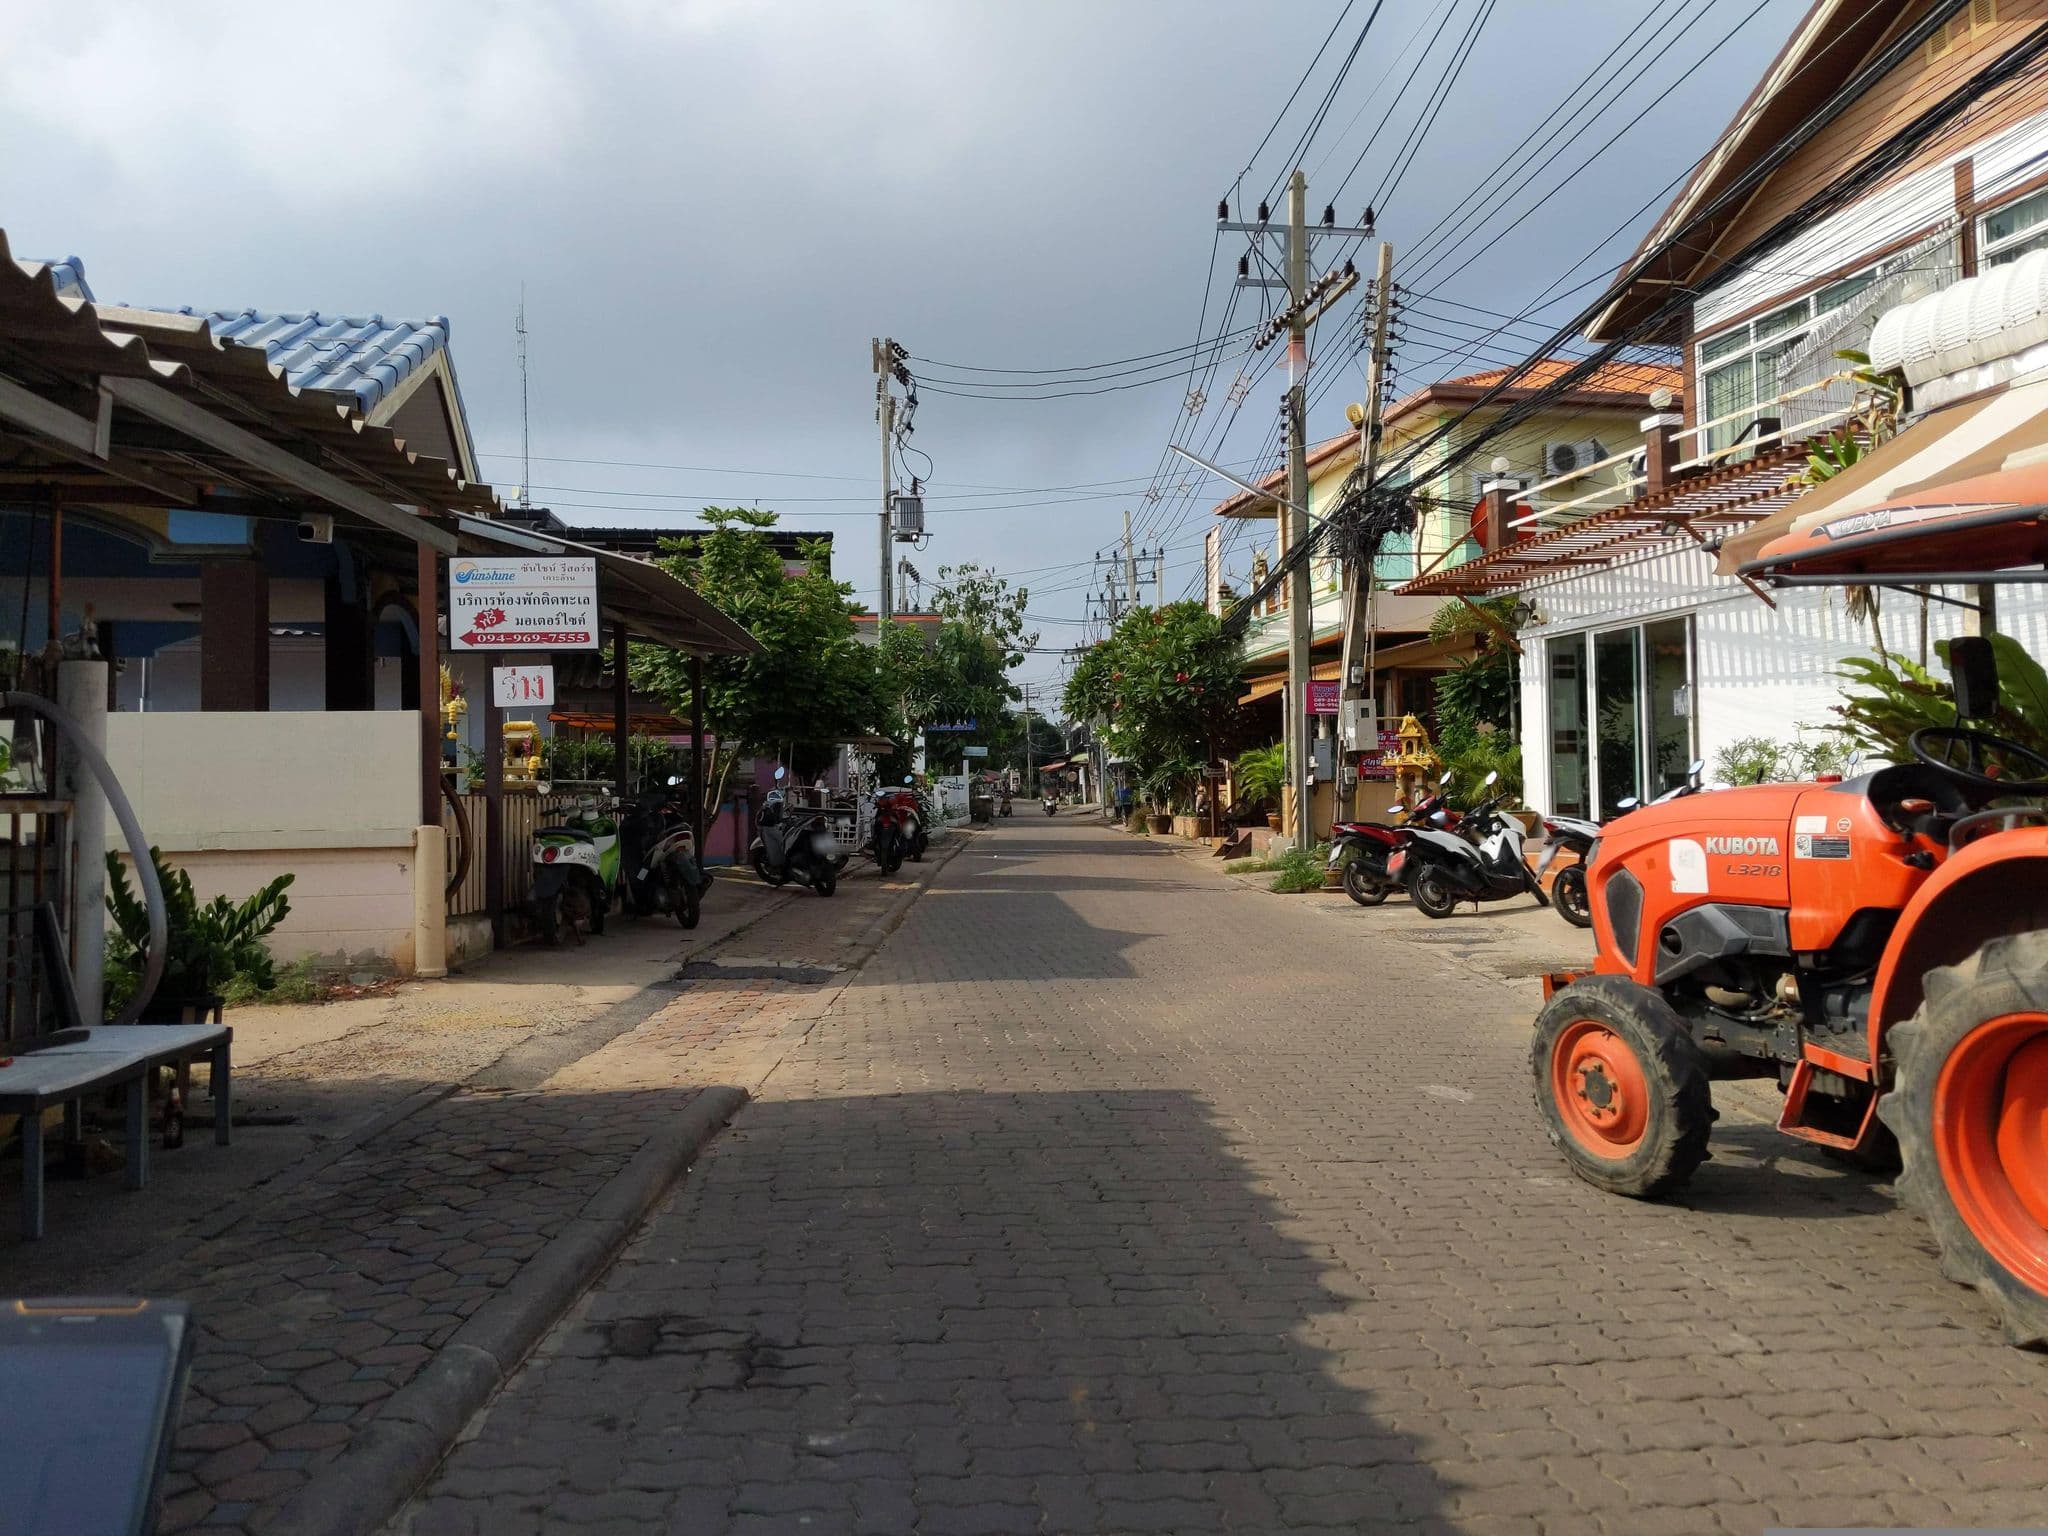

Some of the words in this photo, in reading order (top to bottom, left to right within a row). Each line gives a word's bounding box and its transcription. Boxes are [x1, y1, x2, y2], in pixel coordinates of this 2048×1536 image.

[456, 568, 516, 583] Sunshine
[457, 591, 590, 606] บริการห้องพักติดทะเล
[477, 633, 585, 643] 094-969-7555
[1706, 836, 1779, 856] KUBOTA
[1727, 863, 1782, 877] L3218
